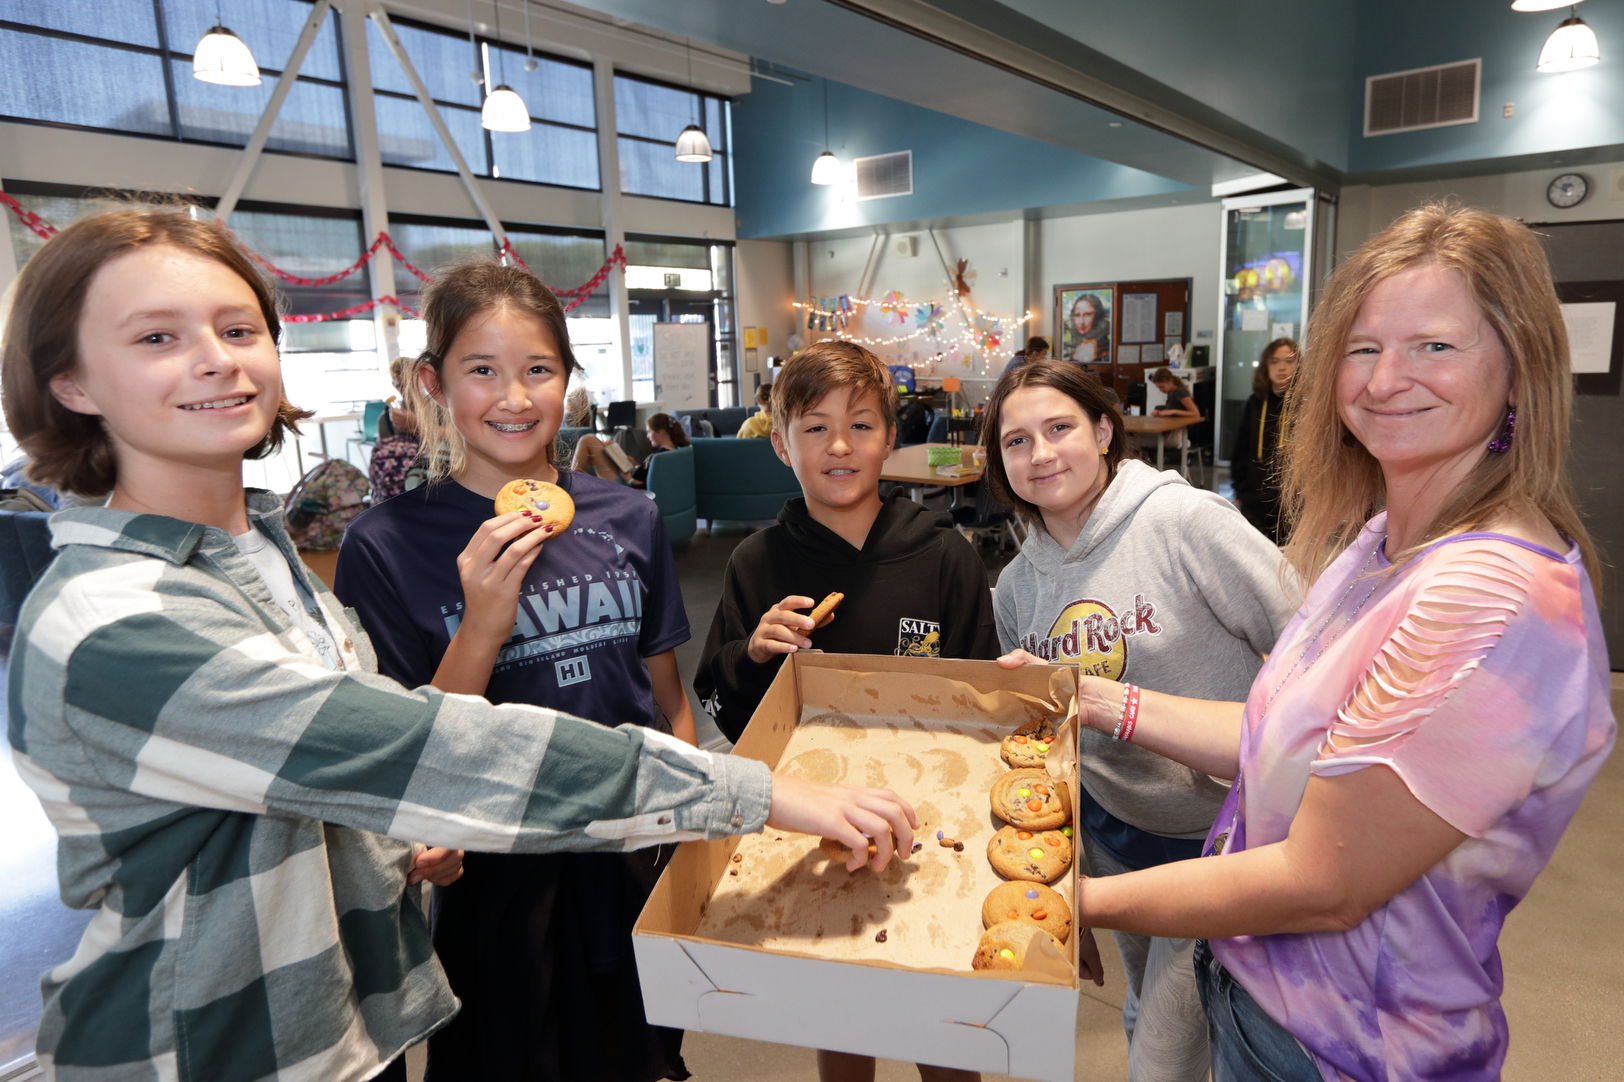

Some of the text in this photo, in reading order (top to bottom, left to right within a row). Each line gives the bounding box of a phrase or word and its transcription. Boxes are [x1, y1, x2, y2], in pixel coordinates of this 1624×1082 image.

[1020, 593, 1161, 661] Hard Rock
[536, 651, 566, 663] ISLAND
[1083, 660, 1111, 676] AFE
